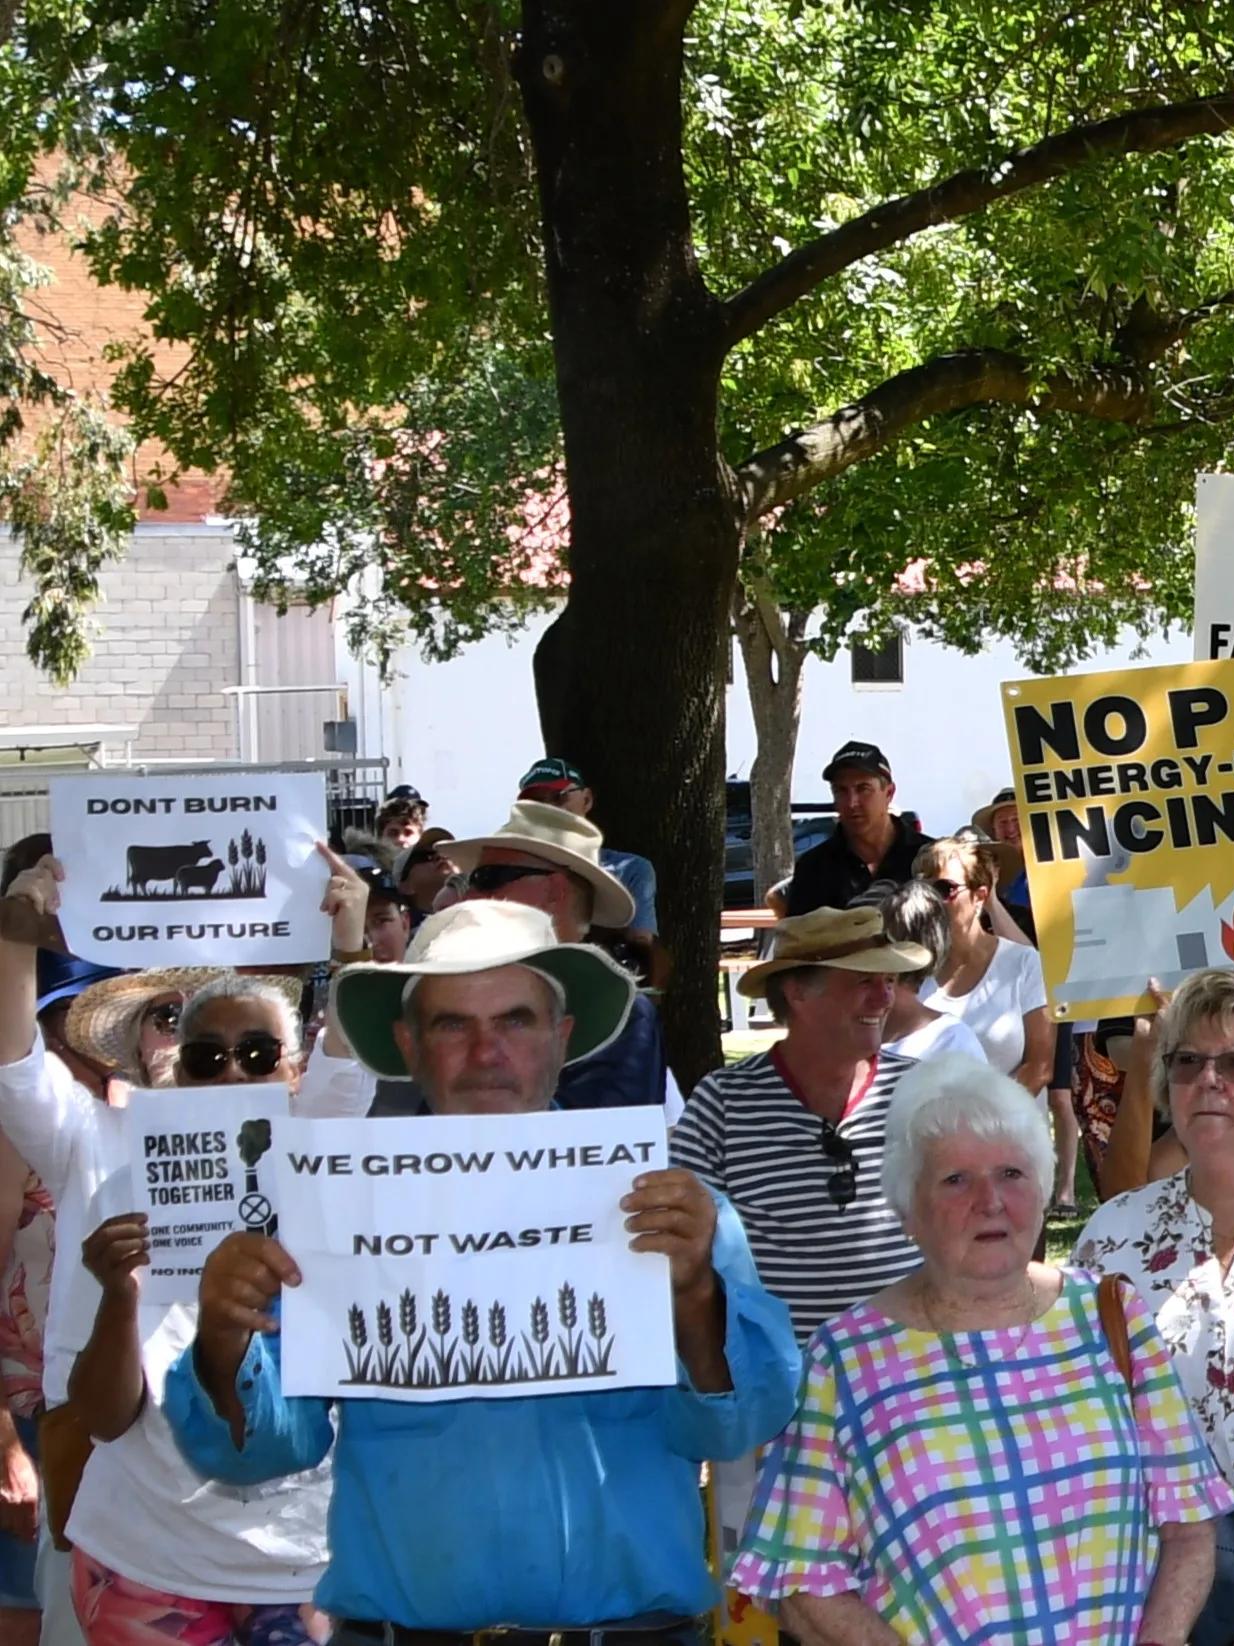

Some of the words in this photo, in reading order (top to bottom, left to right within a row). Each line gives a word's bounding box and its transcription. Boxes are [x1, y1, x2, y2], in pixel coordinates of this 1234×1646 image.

[1017, 697, 1146, 764] NO
[88, 798, 176, 814] DONT
[184, 796, 276, 813] BURN
[93, 926, 158, 941] OUR
[166, 921, 291, 939] FUTURE
[144, 1132, 226, 1157] PARKES
[147, 1158, 228, 1183] STANDS
[288, 1153, 352, 1175] WE
[362, 1152, 494, 1175] GROW
[506, 1142, 656, 1171] WHEAT
[148, 1182, 234, 1206] TOGETHER
[151, 1226, 170, 1236] ONE
[152, 1239, 171, 1248] ONE
[174, 1236, 201, 1247] VOICE
[354, 1235, 438, 1255] NOT
[449, 1224, 592, 1253] WASTE
[151, 1268, 174, 1276] NO
